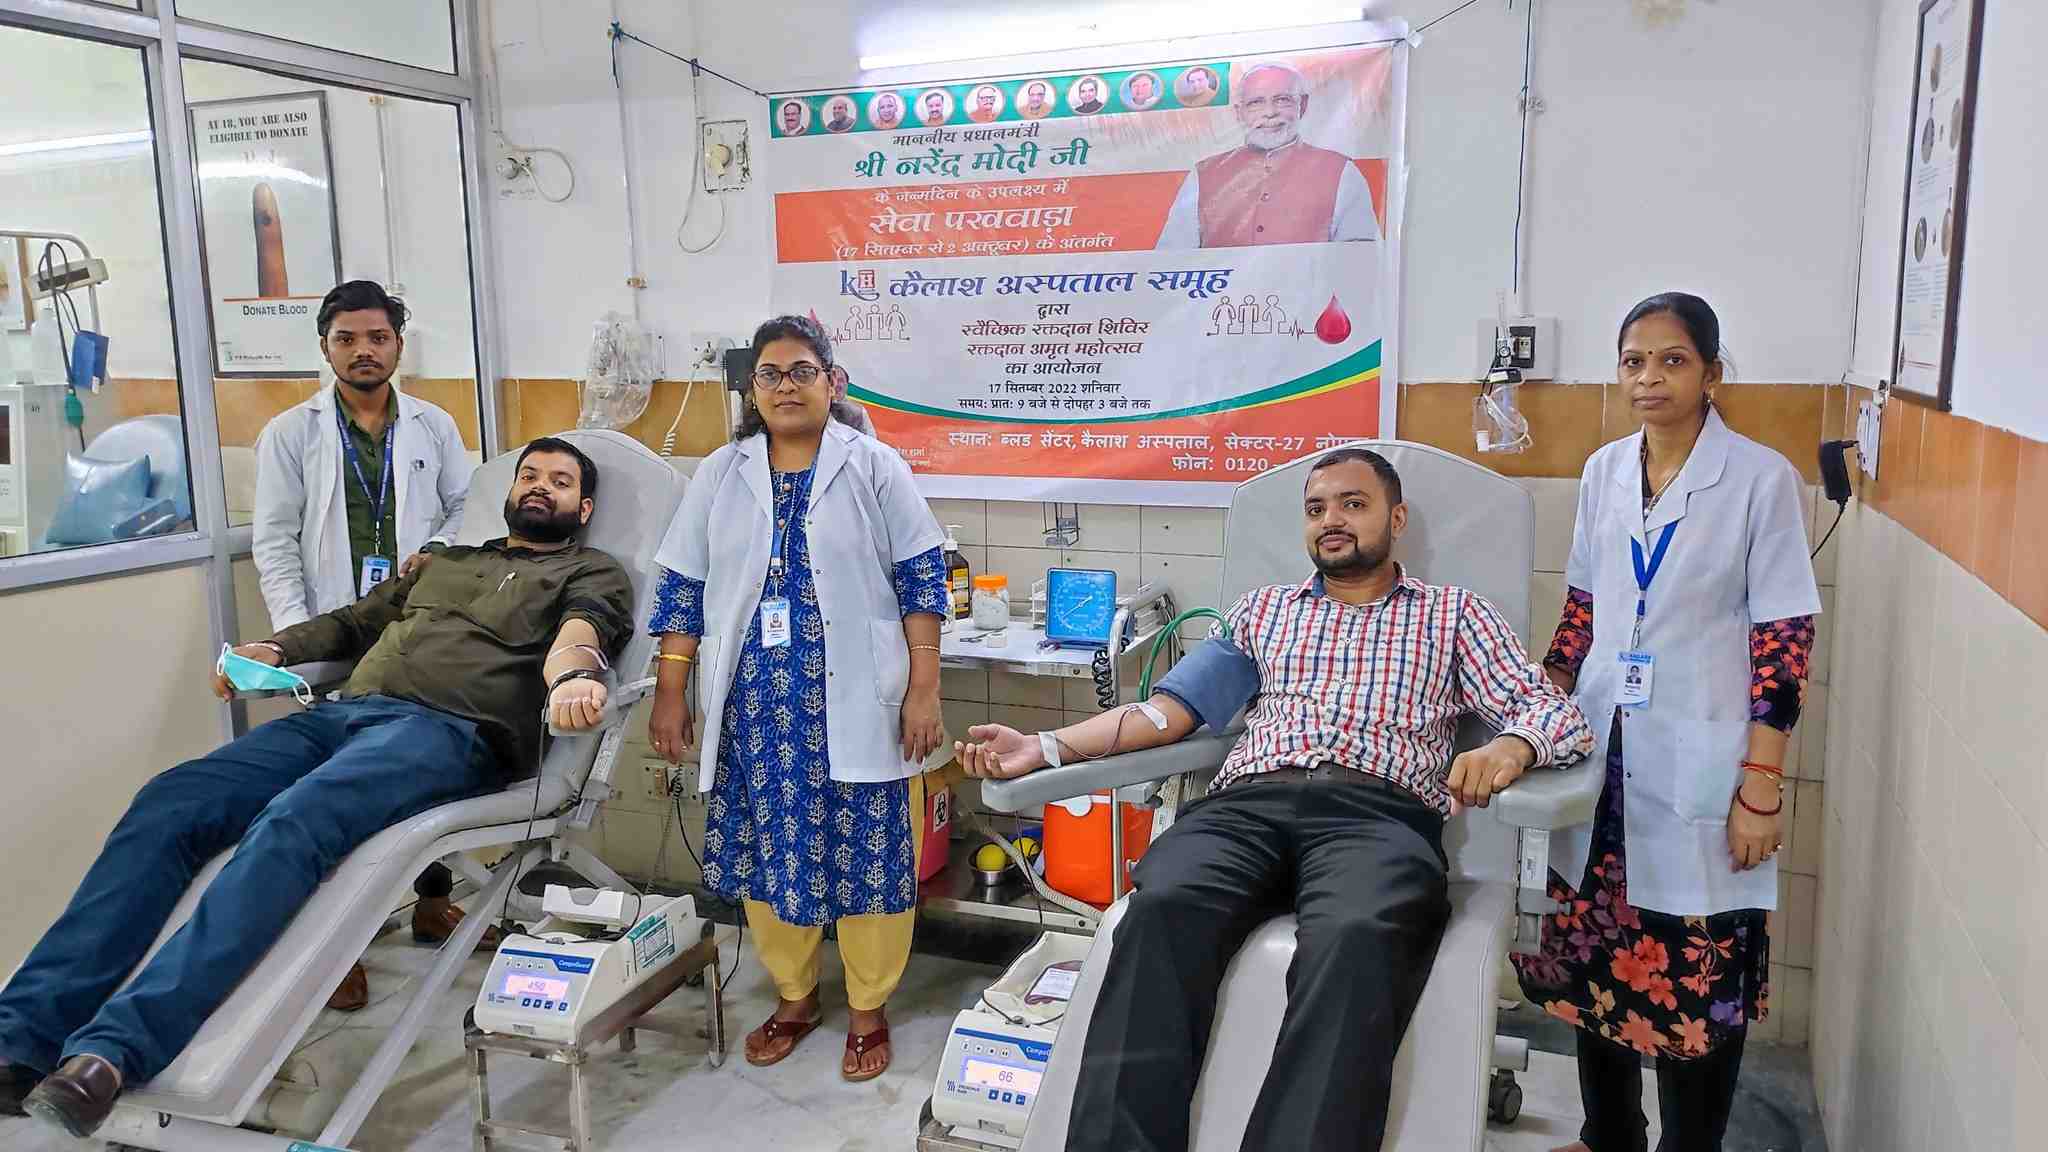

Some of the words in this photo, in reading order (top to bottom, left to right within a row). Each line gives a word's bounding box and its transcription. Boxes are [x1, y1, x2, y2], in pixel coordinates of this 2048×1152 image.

[208, 120, 219, 129] AT
[239, 117, 257, 127] YOU
[262, 114, 280, 125] ARE
[284, 112, 308, 123] ALSO
[209, 131, 252, 144] ELIGIBLE
[255, 130, 268, 140] TO
[270, 126, 308, 138] DONATE
[892, 129, 957, 146] माननीय
[963, 121, 1040, 142] प्रधानमंत्री
[855, 150, 888, 178] श्री
[896, 148, 964, 177] नरेंद्र
[971, 140, 1041, 174] मोदी
[1050, 137, 1093, 166] जी
[873, 189, 889, 204] के
[895, 186, 960, 203] जन्मदिन
[966, 187, 983, 200] के
[1053, 178, 1070, 194] में
[869, 206, 935, 235] सेवा
[944, 205, 1077, 234] पखवाड़ा
[1035, 235, 1055, 250] के
[1058, 233, 1117, 249] अंतर्गत
[888, 270, 988, 298] कैलाश
[996, 271, 1138, 297] अस्पताल
[1148, 268, 1234, 300] समूह
[1036, 303, 1070, 320] द्वारा
[961, 319, 1027, 337] स्वैच्छिक
[1031, 322, 1093, 338] रक्तदान
[1098, 317, 1151, 336] शिविर
[967, 342, 1026, 358] रक्तदान
[1030, 342, 1070, 360] अमृत
[1074, 338, 1144, 357] महोत्सव
[1005, 362, 1029, 376] का
[1032, 359, 1104, 375] आयोजन
[988, 384, 1001, 394] 17
[1005, 380, 1045, 394] सितम्बर
[1048, 383, 1077, 394] 2022
[1080, 380, 1122, 394] शनिवार
[1017, 399, 1024, 410] 9
[1027, 396, 1047, 410] बजे
[1050, 396, 1060, 410] से
[1063, 396, 1096, 411] दोपहर
[1098, 399, 1105, 410] 3
[1108, 396, 1128, 410] बजे
[1131, 399, 1152, 410] तक
[1080, 430, 1129, 449] कैलाश
[1136, 433, 1215, 453] अस्पताल,
[1224, 432, 1305, 451] सेक्टर-27
[998, 1070, 1014, 1082] 66
